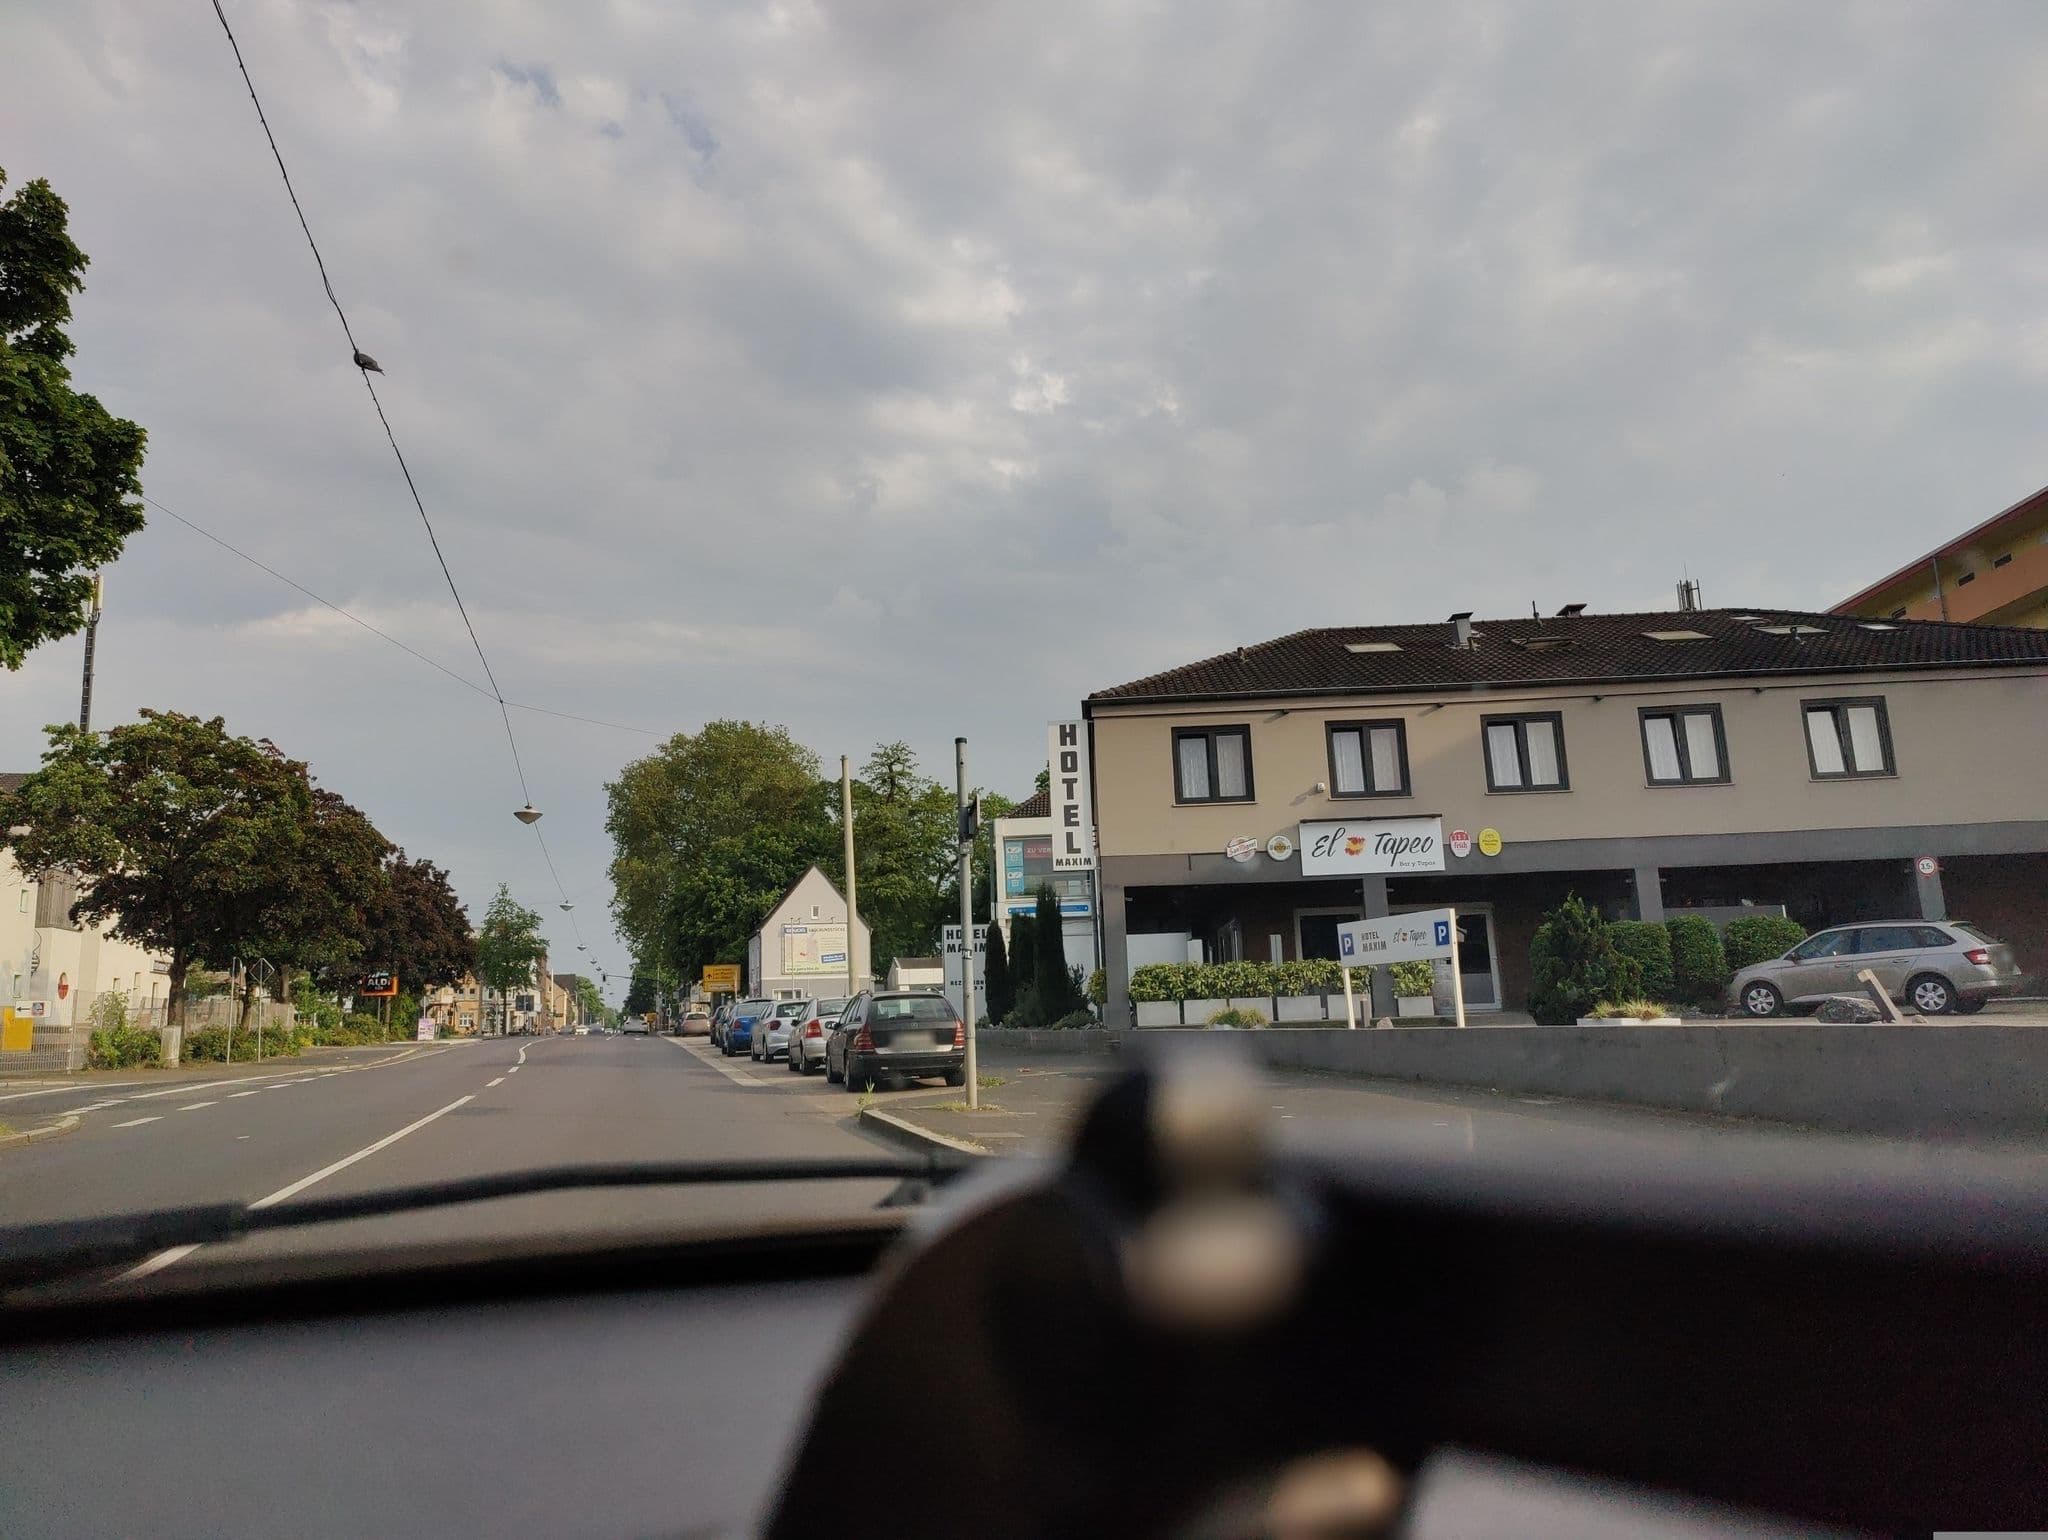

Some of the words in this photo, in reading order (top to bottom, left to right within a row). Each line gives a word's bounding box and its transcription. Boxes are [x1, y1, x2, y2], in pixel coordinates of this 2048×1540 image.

[1059, 724, 1081, 854] HOTEL
[1311, 827, 1346, 858] El
[1374, 832, 1434, 867] Tapeo
[1055, 858, 1092, 867] MAXIM
[946, 929, 987, 940] HOEL
[1361, 931, 1380, 941] HOTEL
[1438, 925, 1447, 942] P
[1344, 940, 1352, 953] P
[1362, 941, 1387, 953] MAXIM
